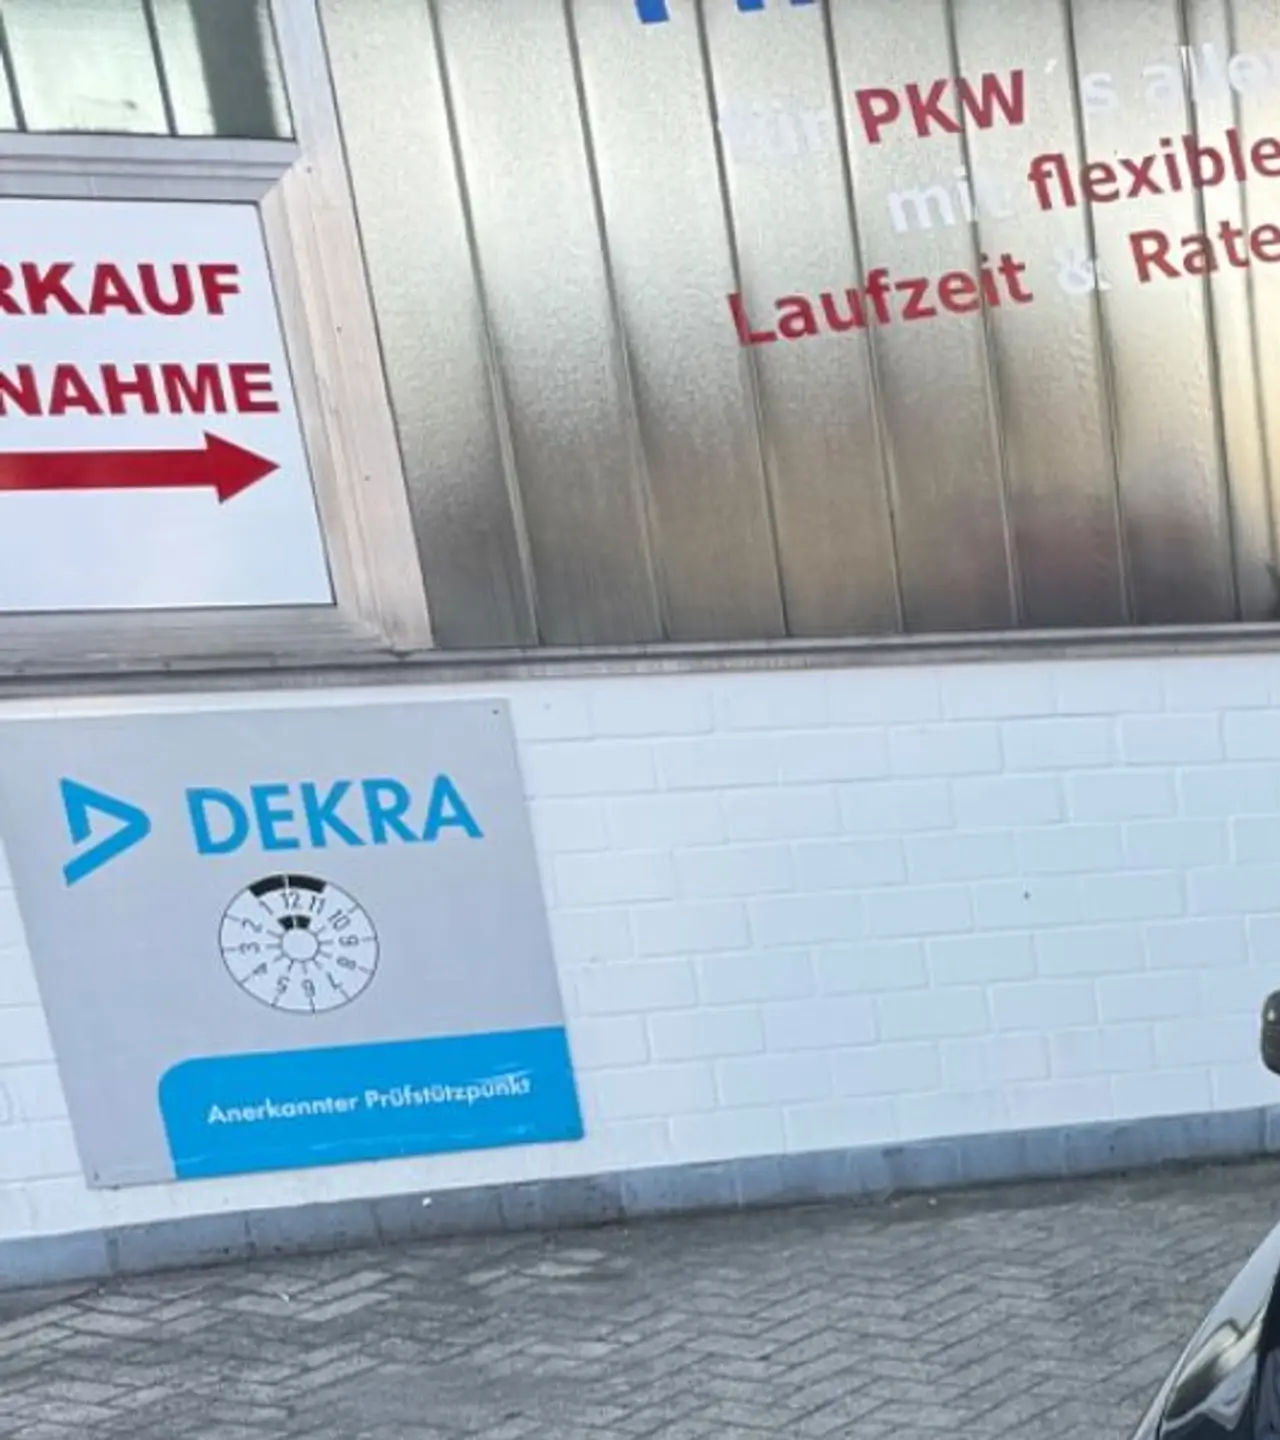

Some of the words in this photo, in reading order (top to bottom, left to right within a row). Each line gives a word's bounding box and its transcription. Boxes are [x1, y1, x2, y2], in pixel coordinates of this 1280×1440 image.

[726, 252, 1034, 347] Laufzeit
[186, 774, 484, 856] DEKRA
[207, 1094, 359, 1125] Anerkannter
[364, 1074, 532, 1110] Prüfstützpunkt
